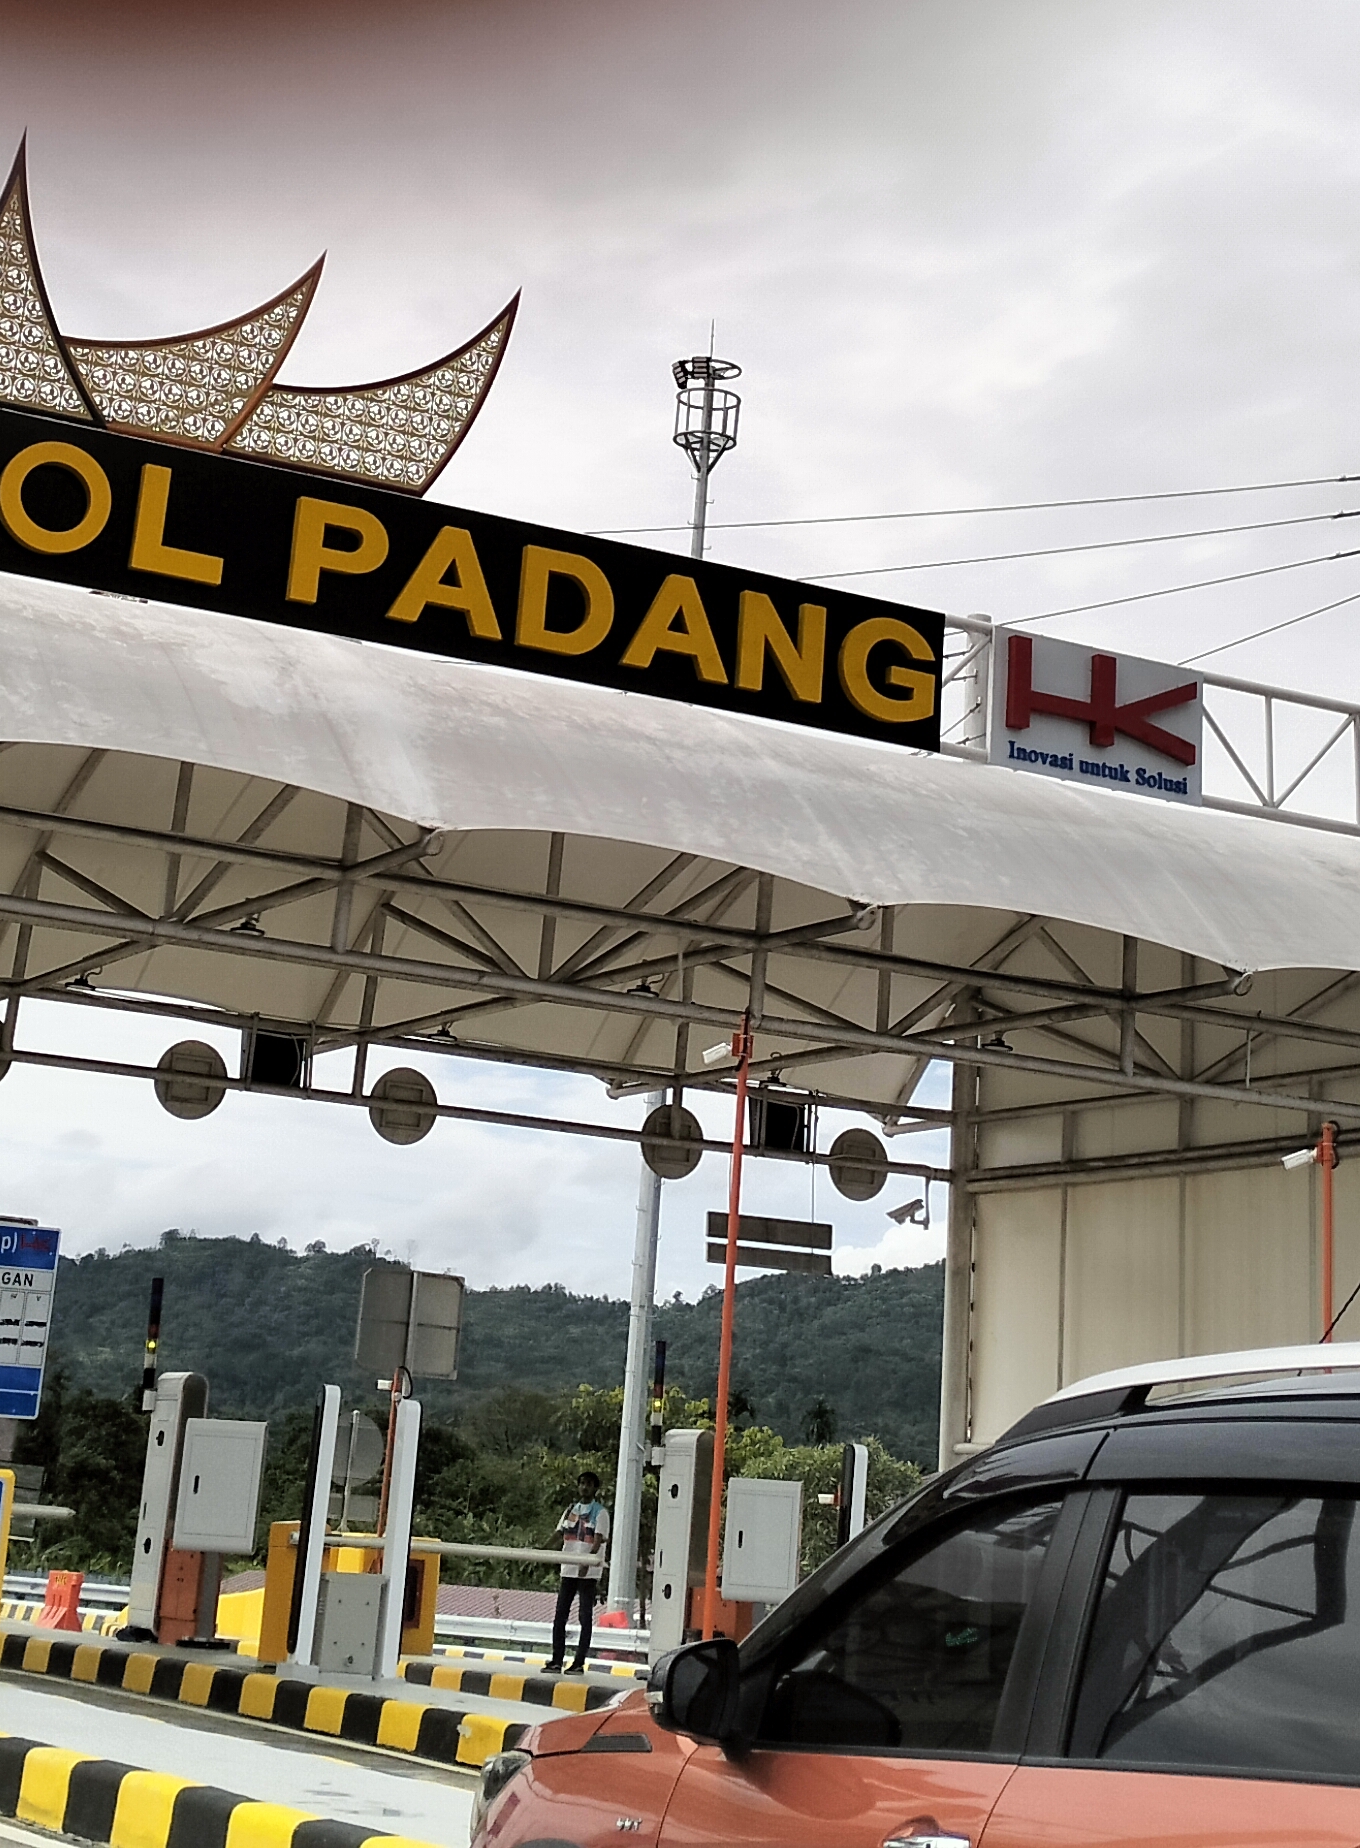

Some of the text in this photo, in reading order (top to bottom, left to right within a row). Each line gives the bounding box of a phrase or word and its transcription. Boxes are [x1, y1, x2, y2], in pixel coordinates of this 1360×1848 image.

[285, 495, 937, 724] PADANG
[1005, 635, 1198, 767] HK
[1008, 740, 1188, 795] Inovasi untuk Solusi
